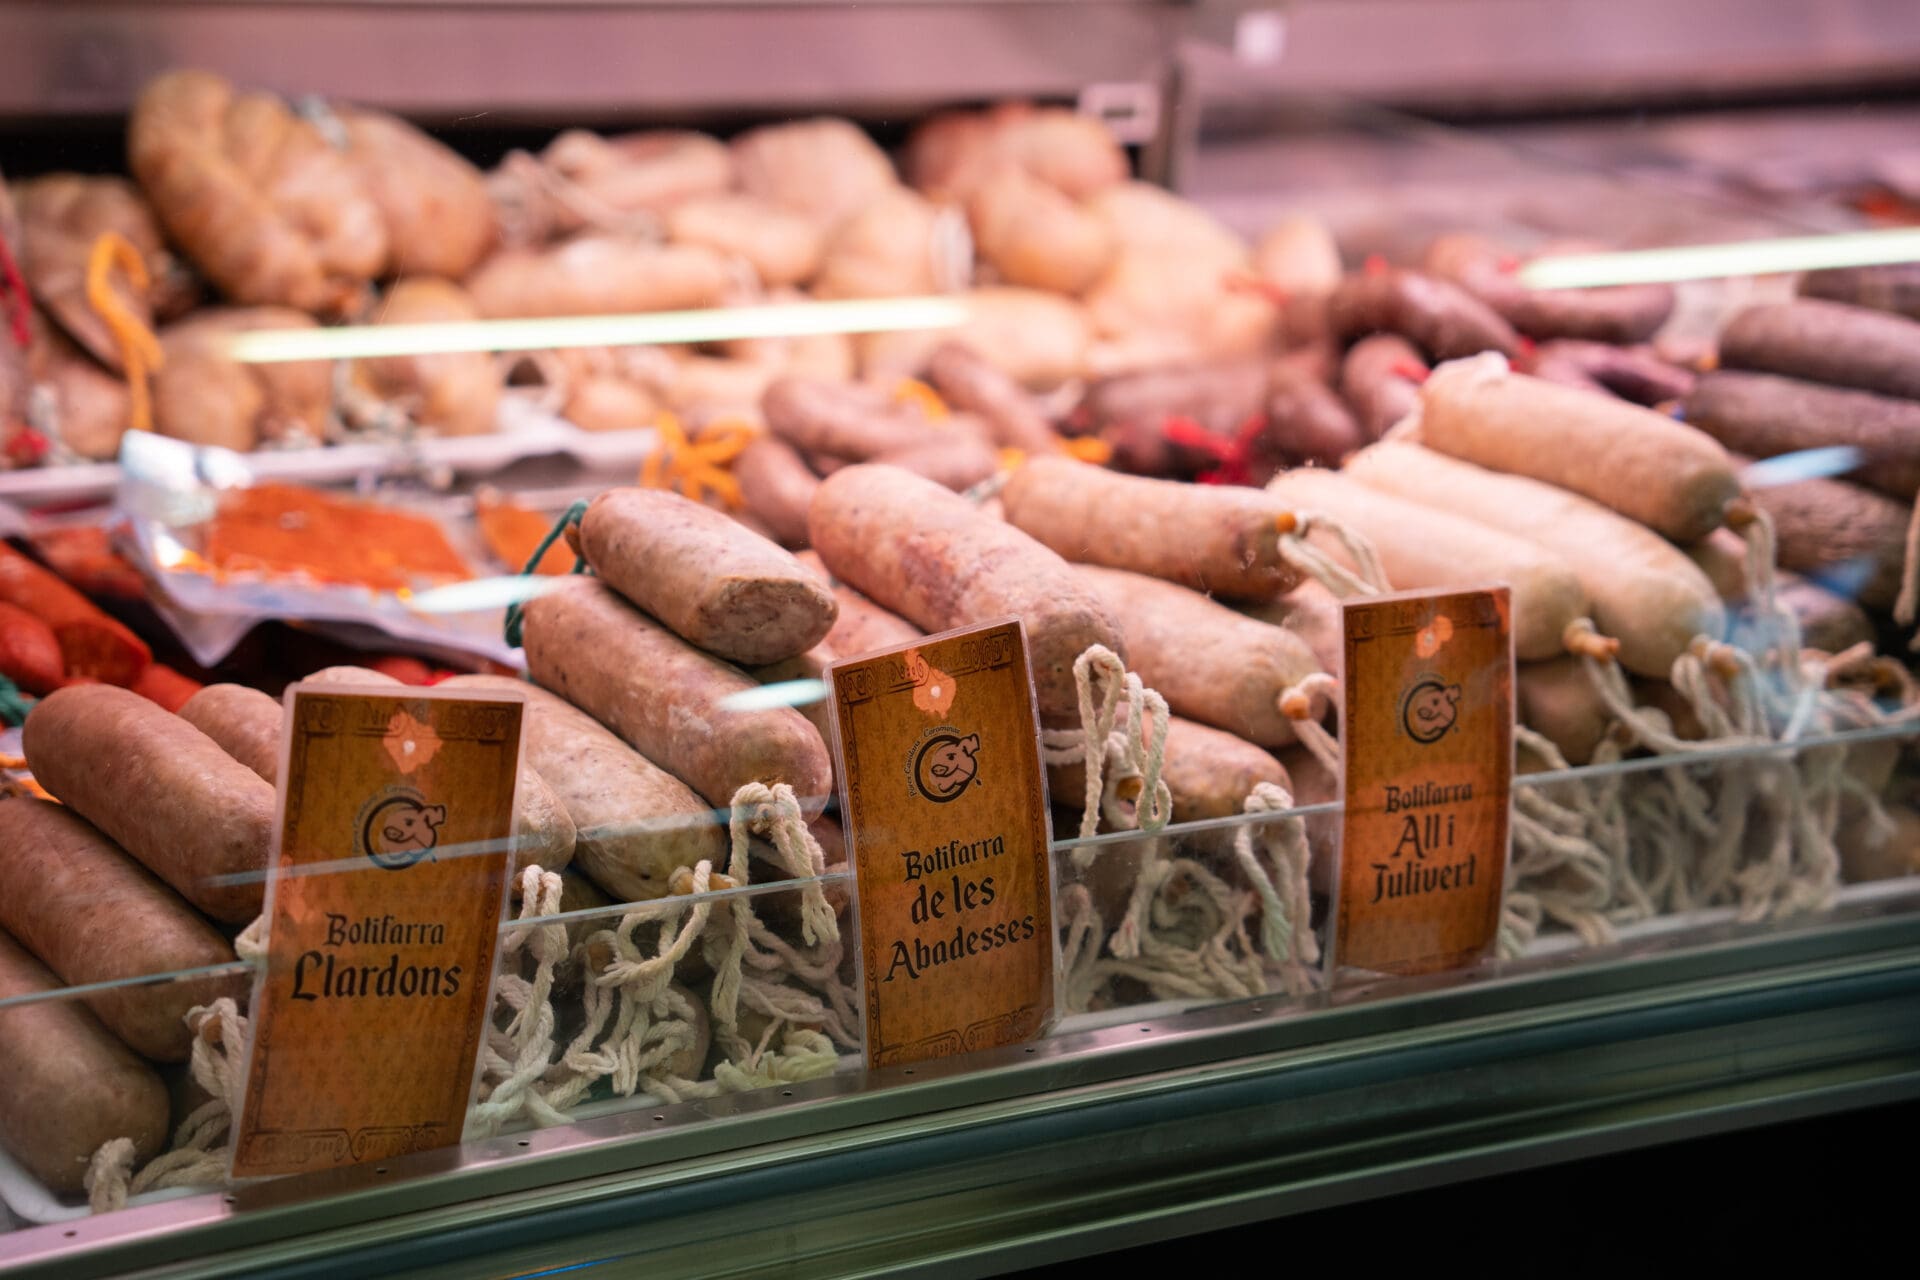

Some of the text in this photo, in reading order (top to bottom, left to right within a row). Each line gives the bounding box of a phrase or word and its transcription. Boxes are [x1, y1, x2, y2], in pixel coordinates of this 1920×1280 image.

[1384, 780, 1473, 814] Botifarra
[901, 833, 1005, 883] Botifarra
[1391, 813, 1455, 858] All i
[910, 875, 996, 925] de les
[1371, 852, 1477, 904] Julivert
[322, 912, 445, 947] Botifarra
[882, 913, 1036, 983] Abadesses
[291, 950, 462, 1002] Llardons
